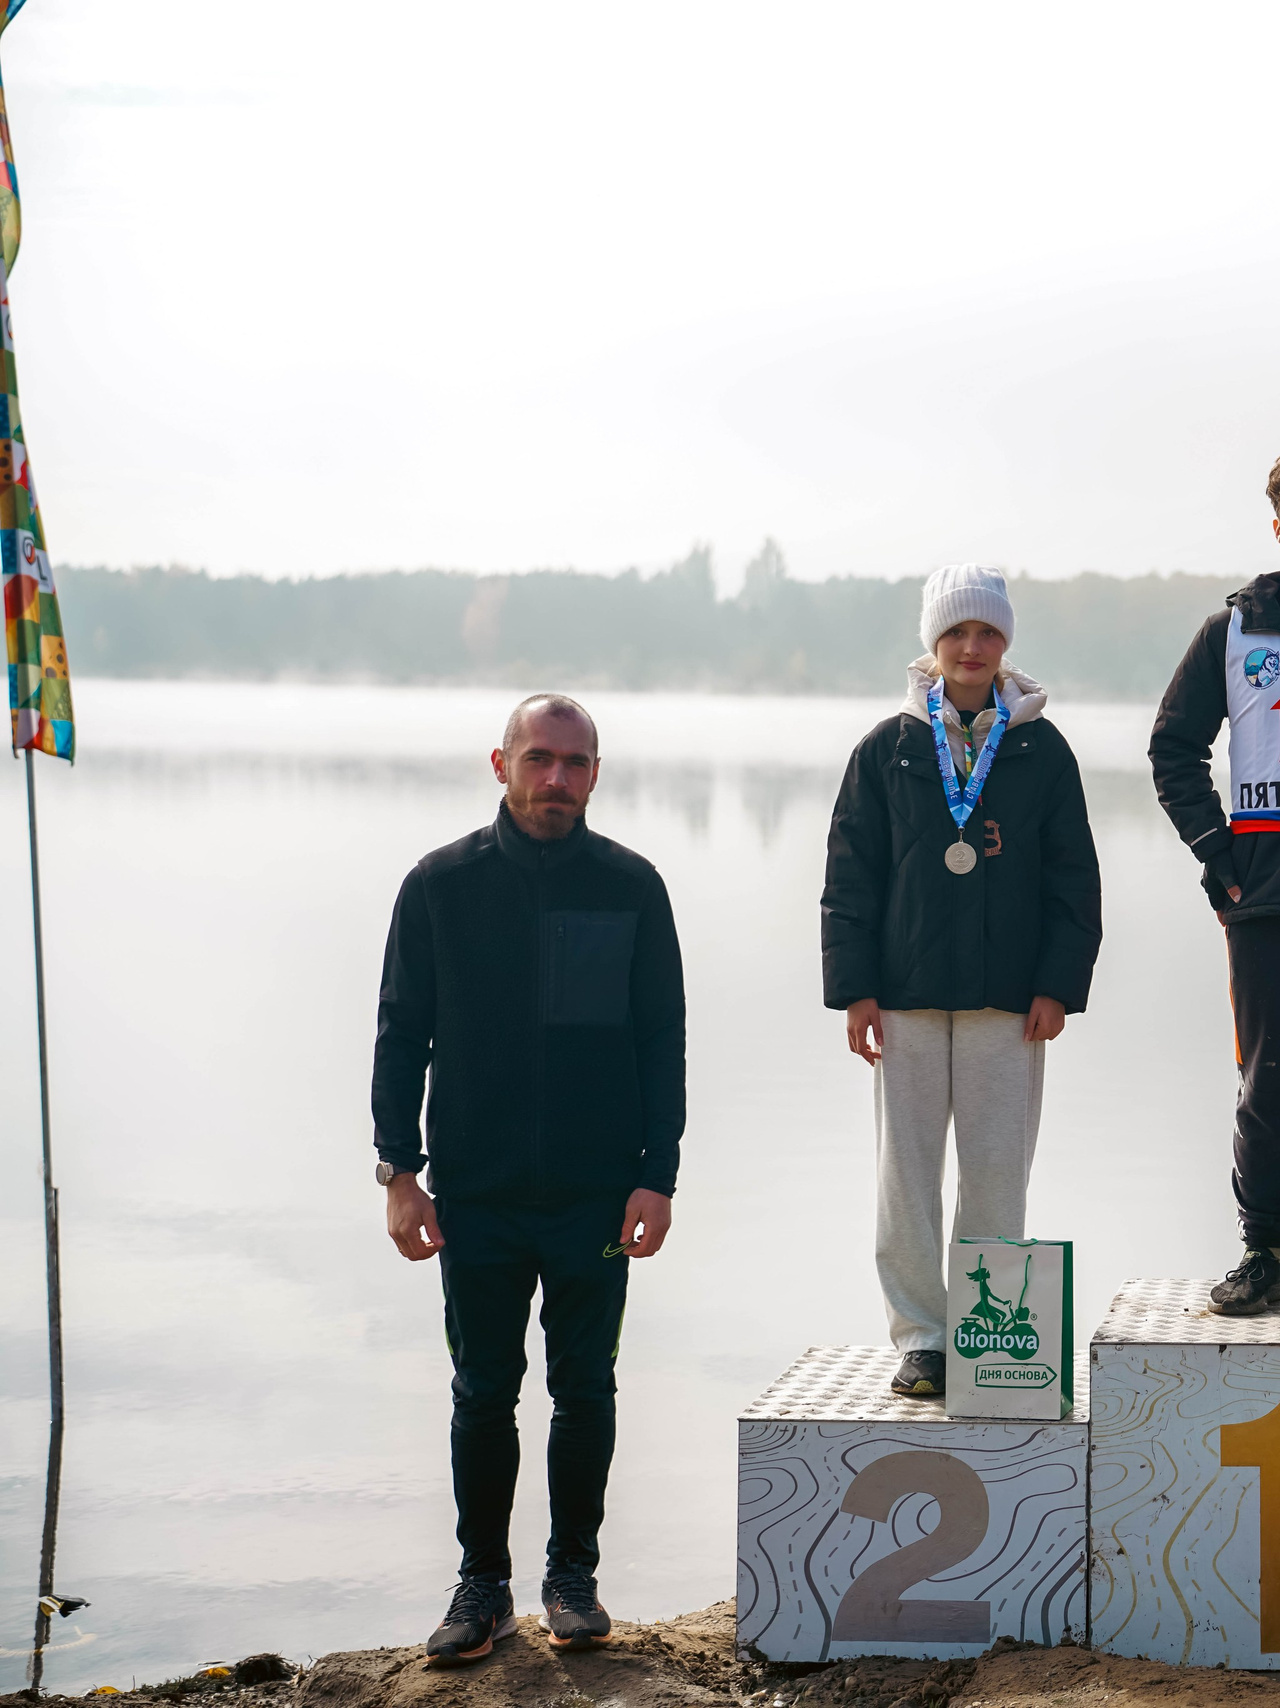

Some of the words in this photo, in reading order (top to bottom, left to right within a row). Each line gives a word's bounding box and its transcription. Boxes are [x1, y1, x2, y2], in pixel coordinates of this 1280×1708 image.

[941, 751, 958, 799] СТАВРОПОЛЬЕ
[966, 753, 992, 799] СТАВРОПОЛЬЕ
[956, 850, 966, 862] 2
[957, 1327, 1037, 1349] bionova
[979, 1370, 1001, 1381] ДНЯ
[1004, 1370, 1048, 1380] ОСНОВА
[832, 1451, 990, 1643] 2
